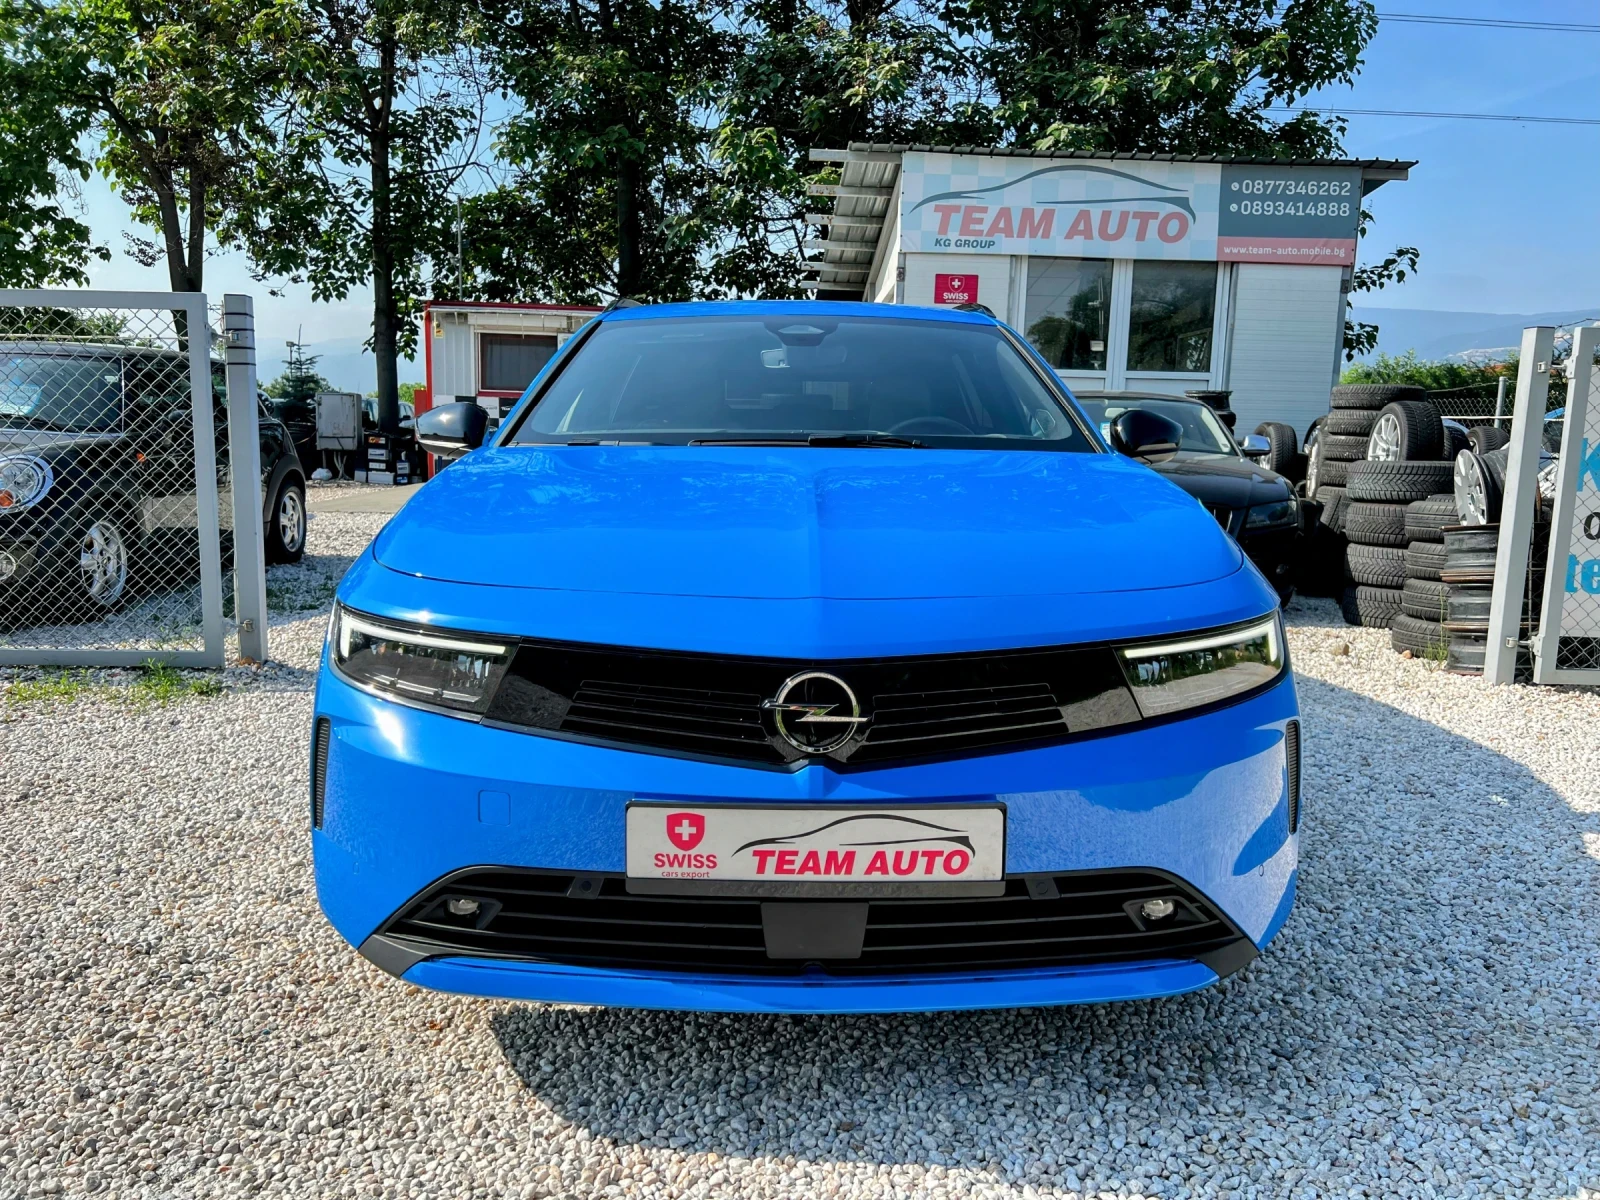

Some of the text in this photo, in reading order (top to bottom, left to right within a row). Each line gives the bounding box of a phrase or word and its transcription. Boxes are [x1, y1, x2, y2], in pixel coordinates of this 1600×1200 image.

[1242, 180, 1351, 196] 0877346262
[1241, 201, 1350, 216] 0893414888
[934, 204, 1189, 244] TEAM AUTO
[934, 238, 996, 249] KG GROUP
[1223, 246, 1346, 257] www.team-auto.mobile.bg
[943, 292, 969, 300] SWISS
[653, 853, 718, 869] SWISS
[752, 850, 970, 876] TEAM AUTO
[681, 871, 710, 880] export
